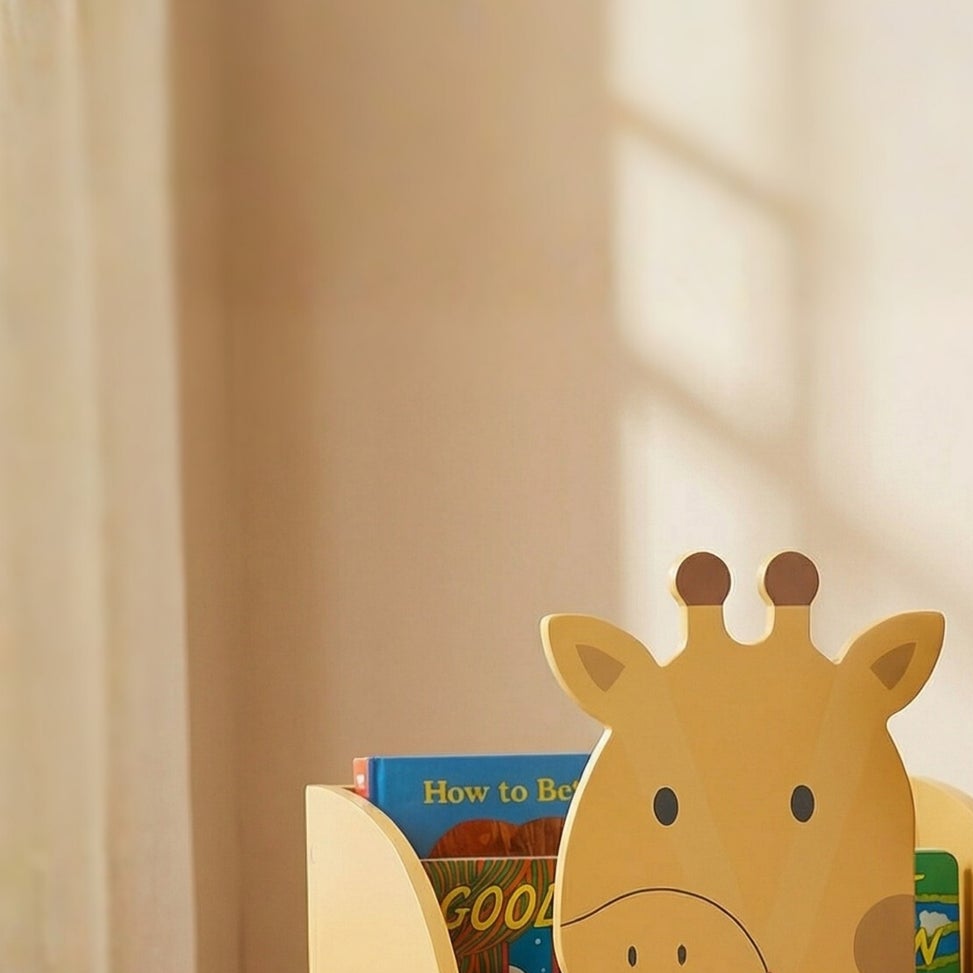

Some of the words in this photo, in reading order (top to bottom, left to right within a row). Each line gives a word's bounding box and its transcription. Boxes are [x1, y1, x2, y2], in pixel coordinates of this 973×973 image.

[424, 780, 490, 804] How
[498, 781, 528, 803] to
[537, 778, 579, 802] Be
